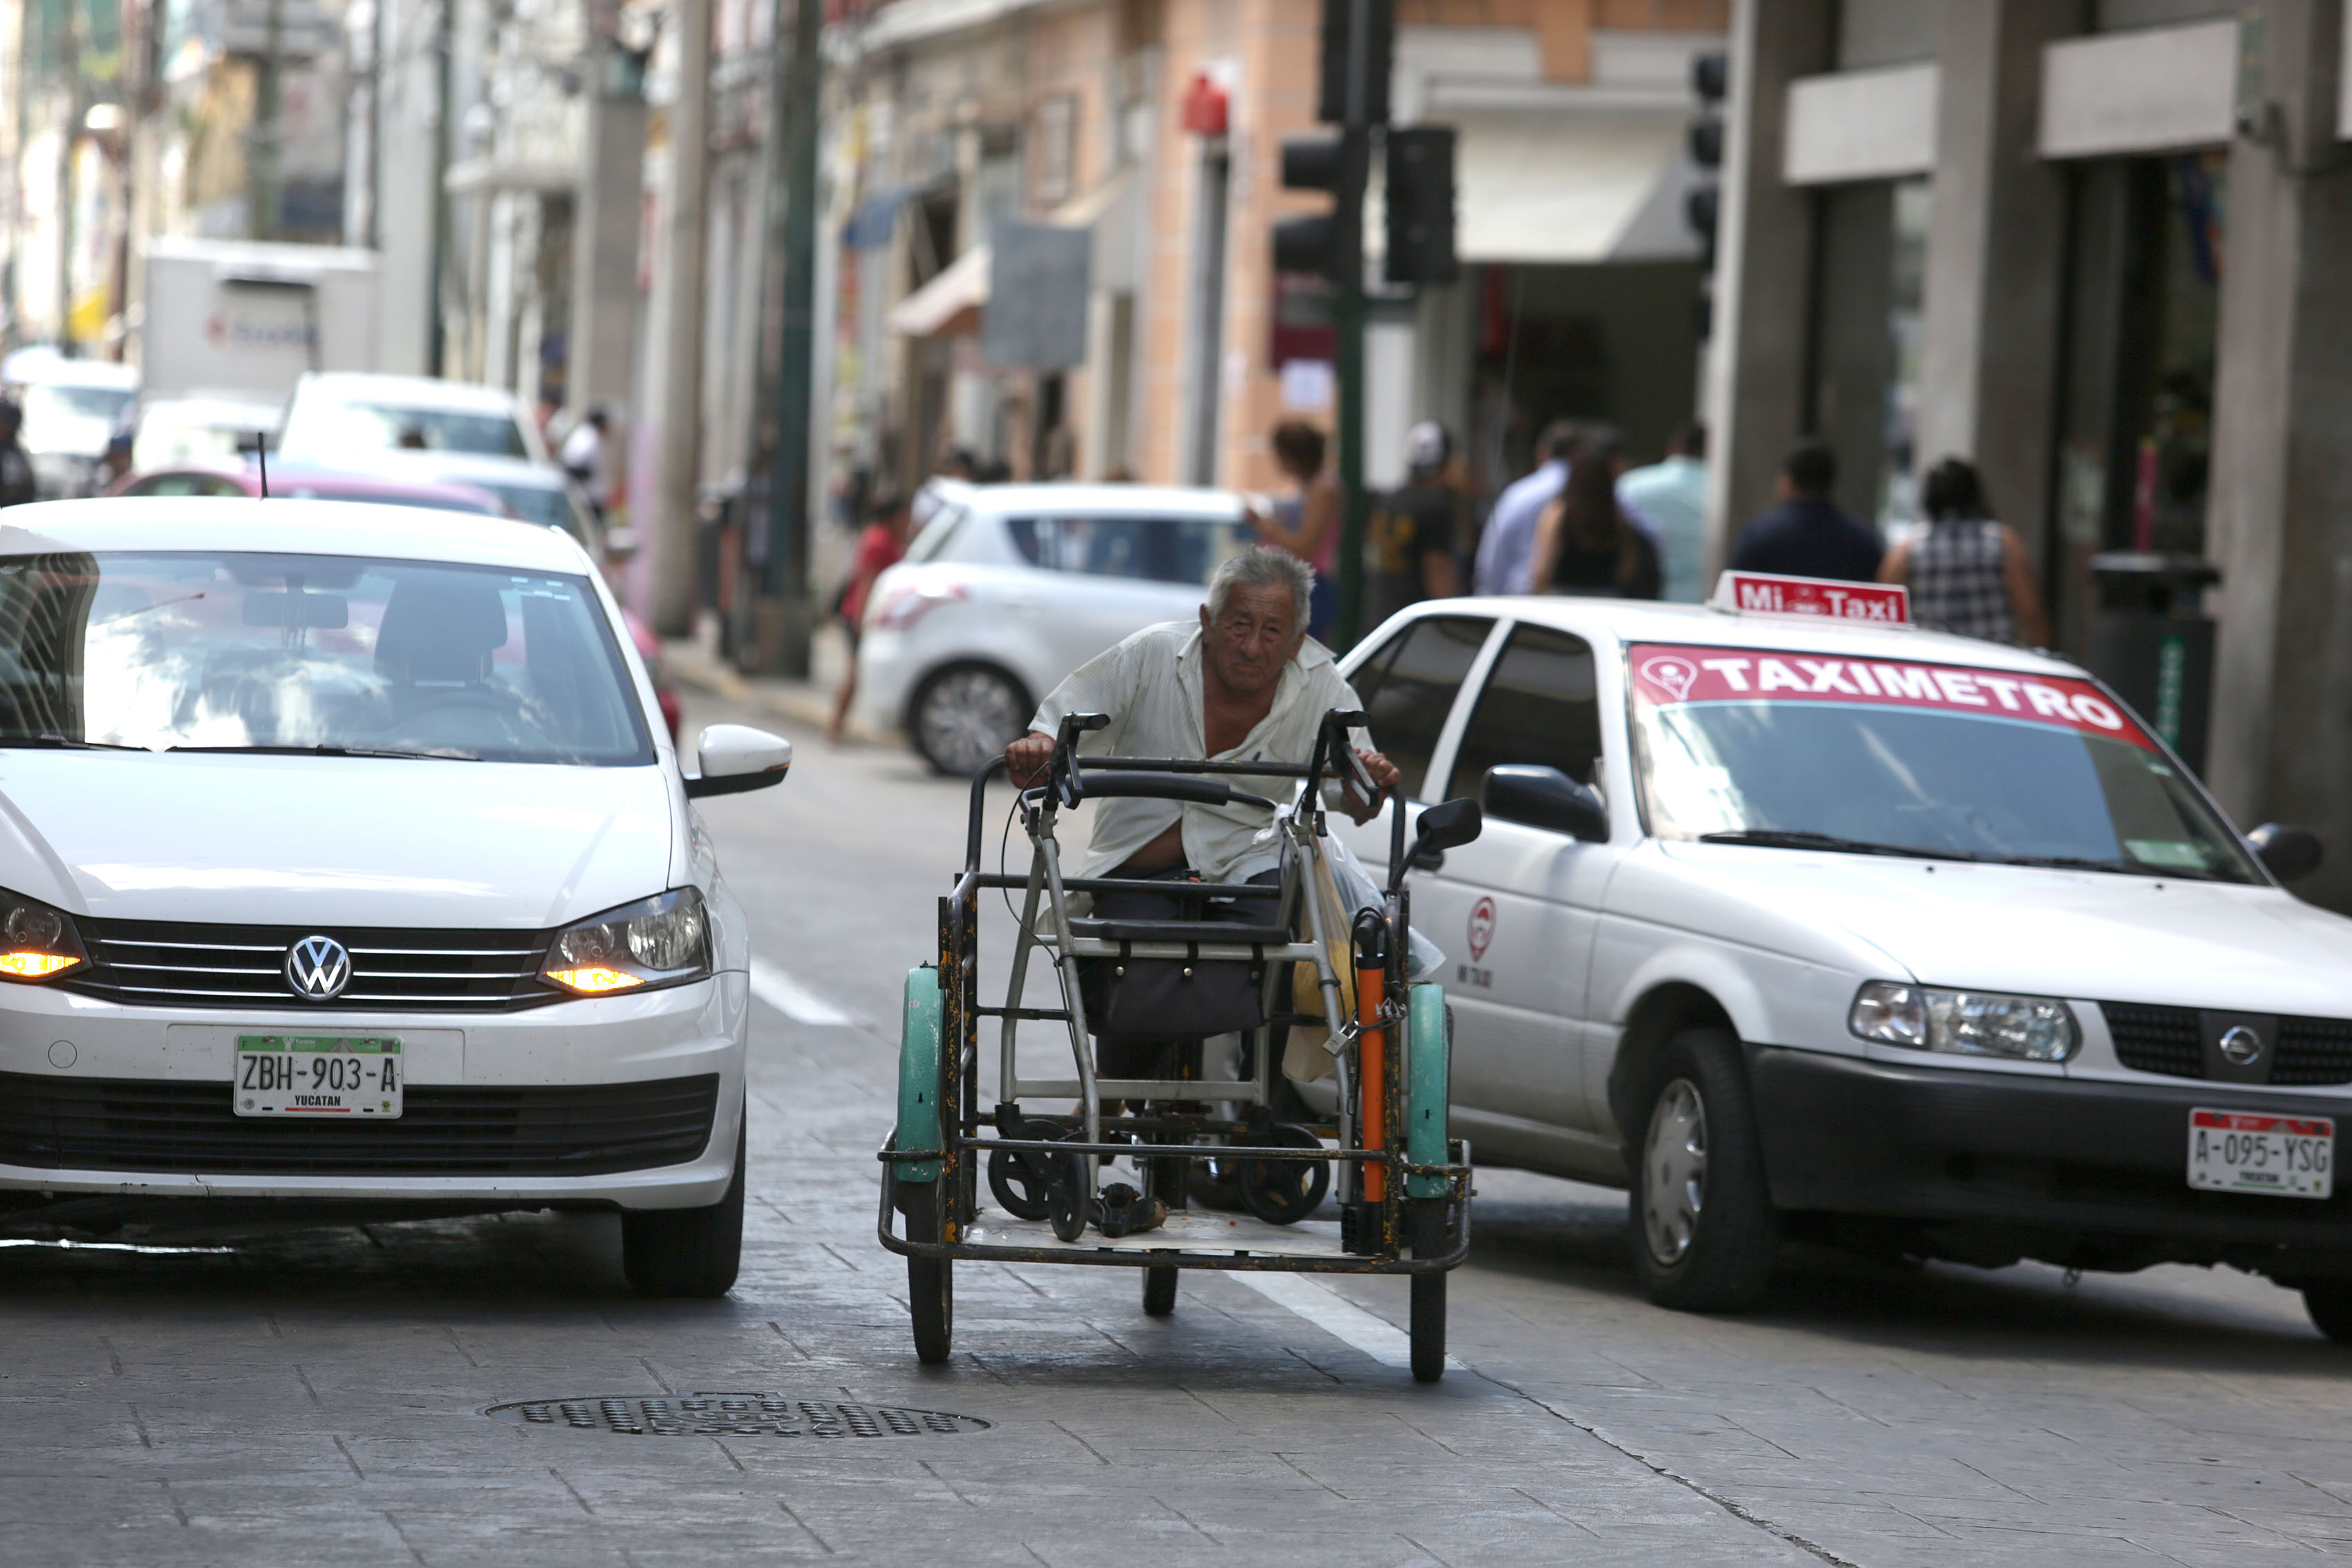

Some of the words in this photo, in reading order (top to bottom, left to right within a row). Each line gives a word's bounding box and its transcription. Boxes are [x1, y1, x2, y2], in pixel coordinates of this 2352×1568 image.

[1740, 583, 1784, 613] Mi
[1823, 590, 1898, 622] Taxi
[1701, 657, 2123, 731] TAXIMETRO
[243, 1055, 395, 1092] ZBH-903-A
[295, 1095, 341, 1106] YUCATAN
[2195, 1129, 2328, 1173] A-095-YSG
